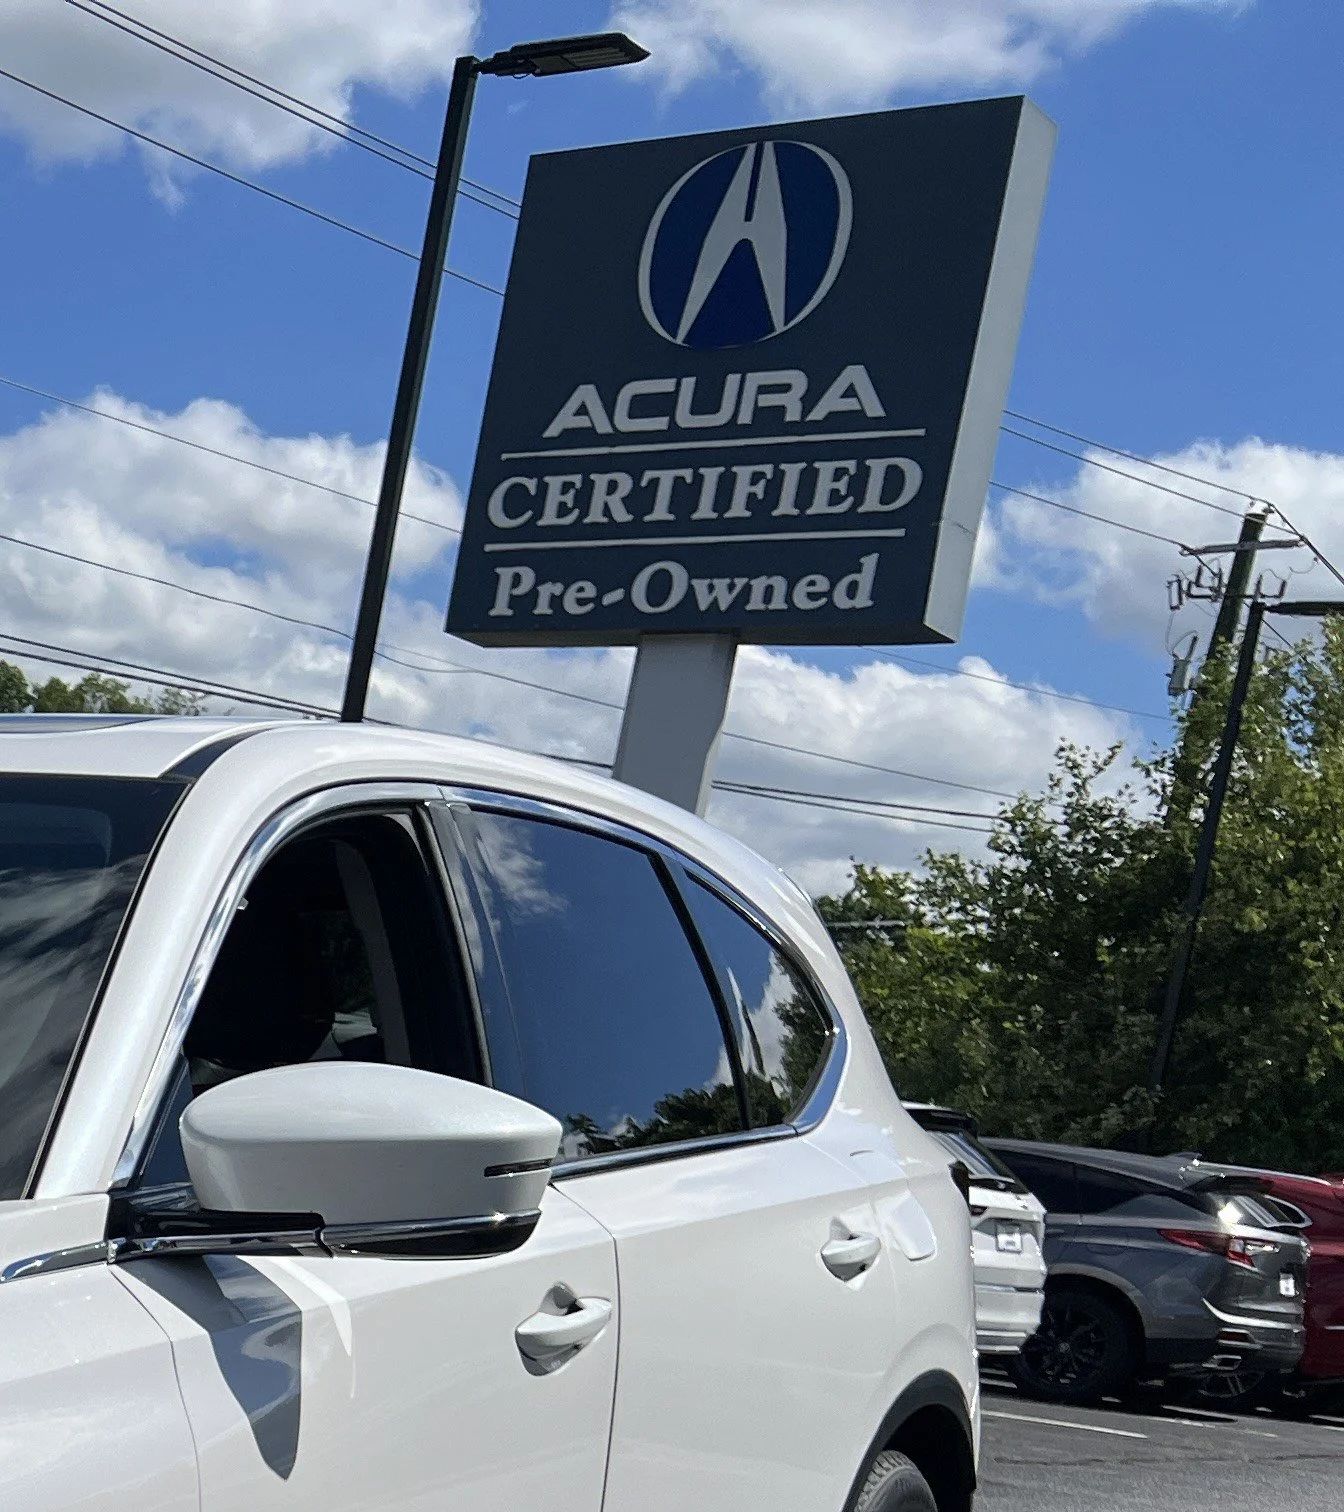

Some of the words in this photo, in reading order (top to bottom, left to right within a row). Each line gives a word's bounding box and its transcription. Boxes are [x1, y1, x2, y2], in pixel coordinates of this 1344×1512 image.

[542, 364, 887, 439] ACURA
[485, 456, 923, 530] CERTIFIED
[487, 553, 880, 617] Pre-Owned
